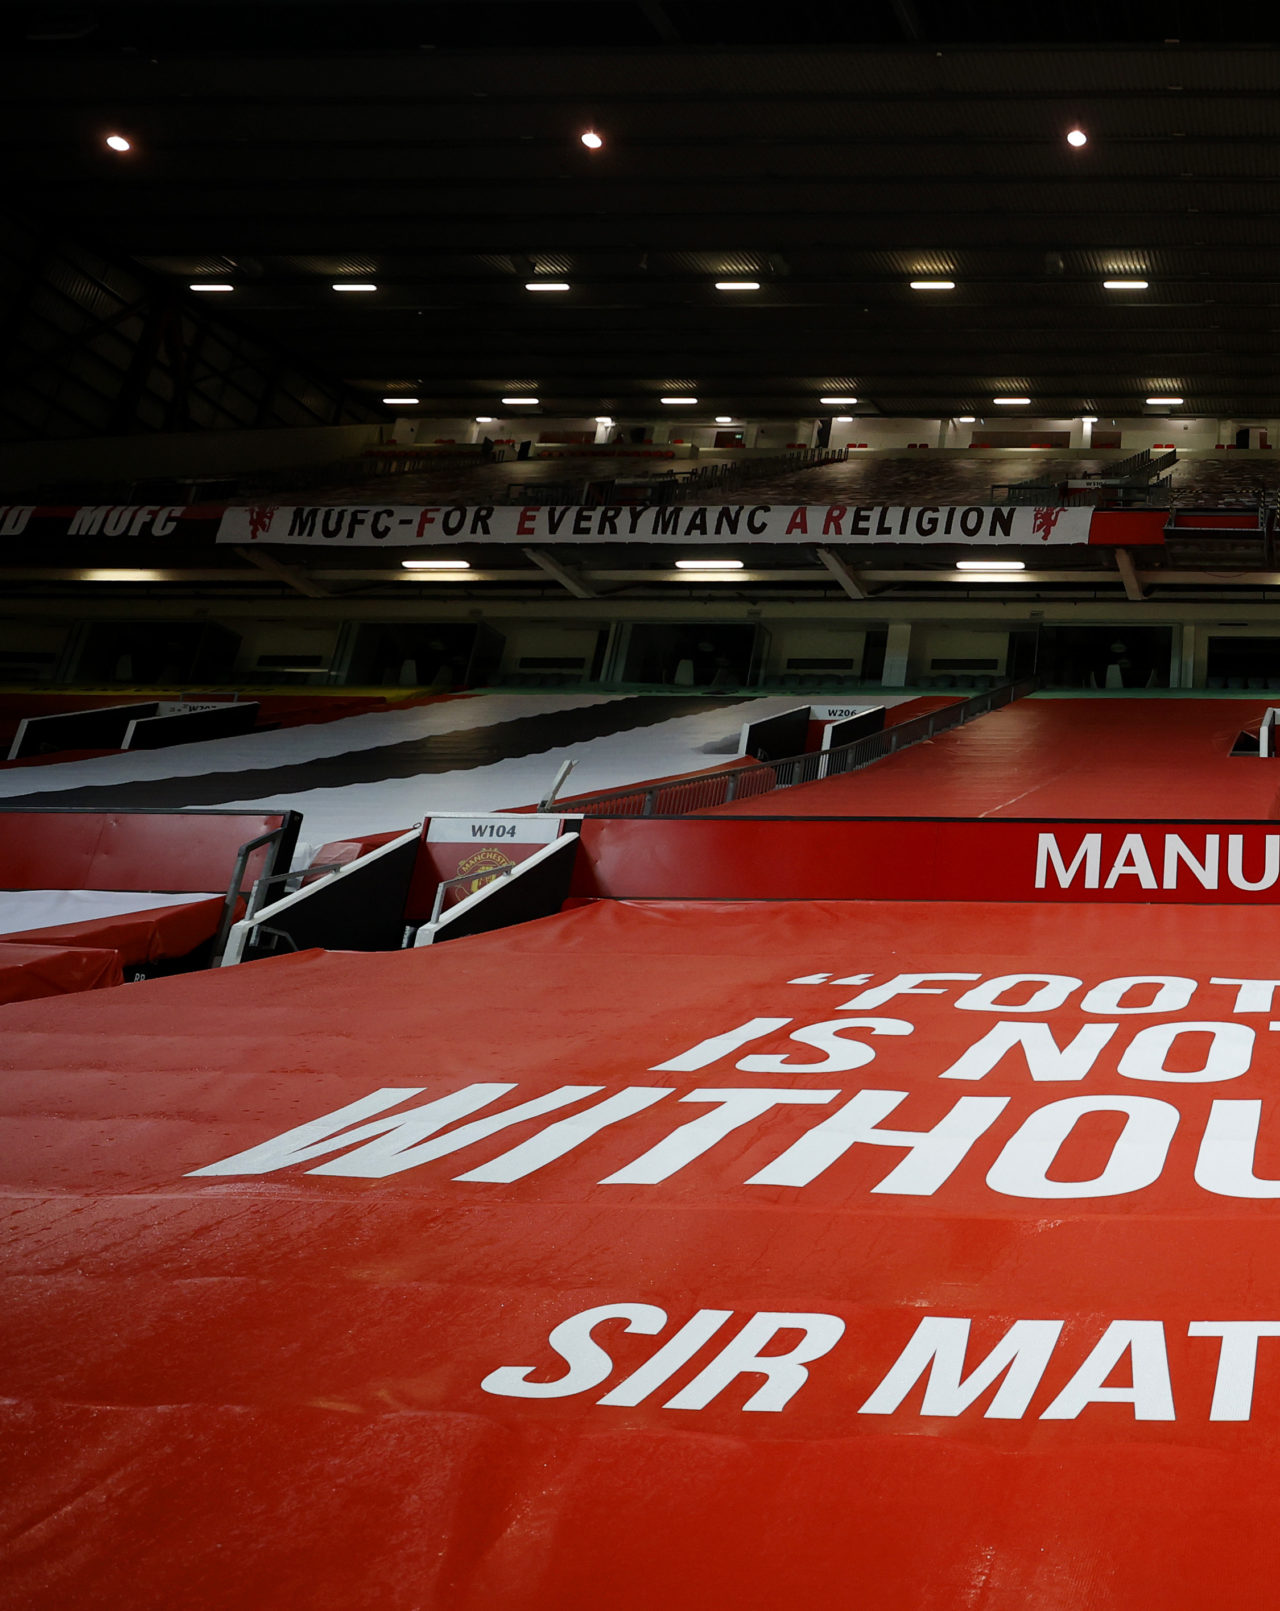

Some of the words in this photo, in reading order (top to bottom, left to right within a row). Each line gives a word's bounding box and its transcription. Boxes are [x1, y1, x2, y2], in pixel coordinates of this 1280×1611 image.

[0, 505, 38, 536] D
[67, 505, 187, 536] MUFC
[288, 506, 494, 539] MUFC-FOR
[517, 505, 771, 535] EVERYMANC
[785, 506, 808, 535] A
[822, 506, 1016, 537] RELIGION
[828, 709, 857, 717] W206
[471, 825, 516, 838] W104
[647, 1017, 915, 1074] IS
[480, 1302, 847, 1413] SIR
